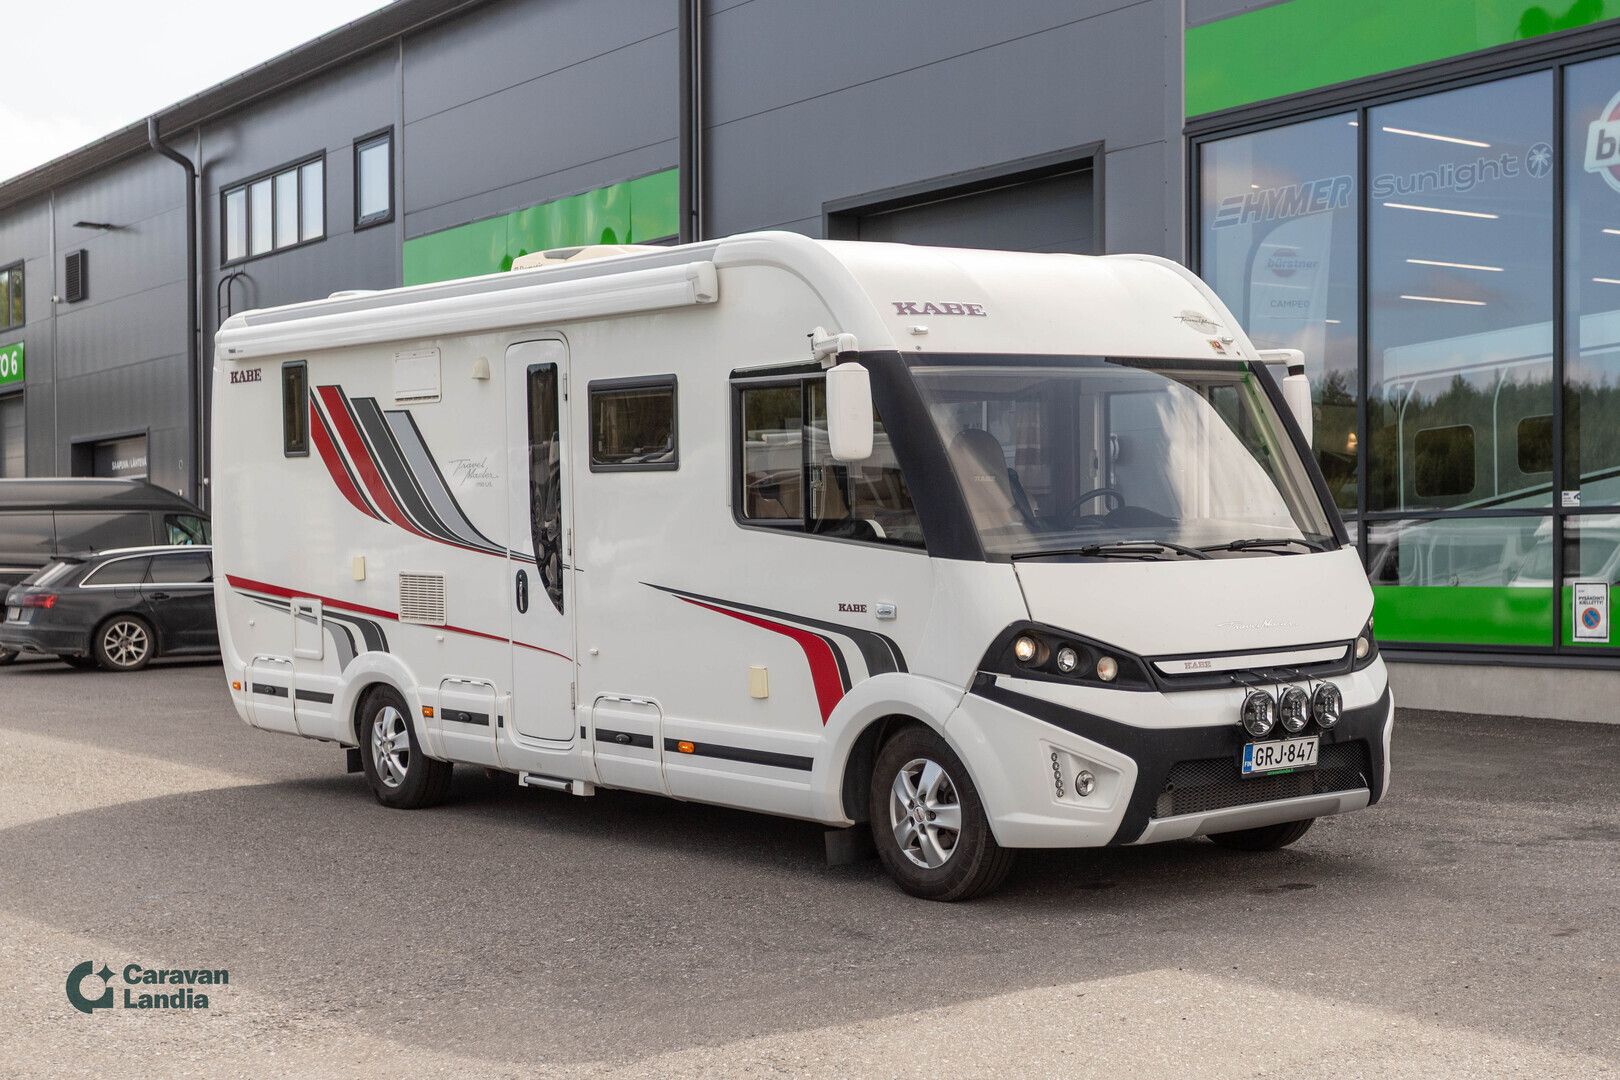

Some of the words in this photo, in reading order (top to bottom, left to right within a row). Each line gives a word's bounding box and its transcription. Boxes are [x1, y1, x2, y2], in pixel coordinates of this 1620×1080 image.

[1596, 128, 1620, 160] b
[1372, 153, 1520, 199] Sunlight
[1238, 175, 1353, 225] HYMER
[892, 301, 987, 317] KABE
[0, 353, 9, 377] O
[11, 351, 18, 375] 6
[230, 368, 262, 383] KABE
[838, 603, 867, 613] KABE
[1255, 741, 1315, 767] GRJ-847
